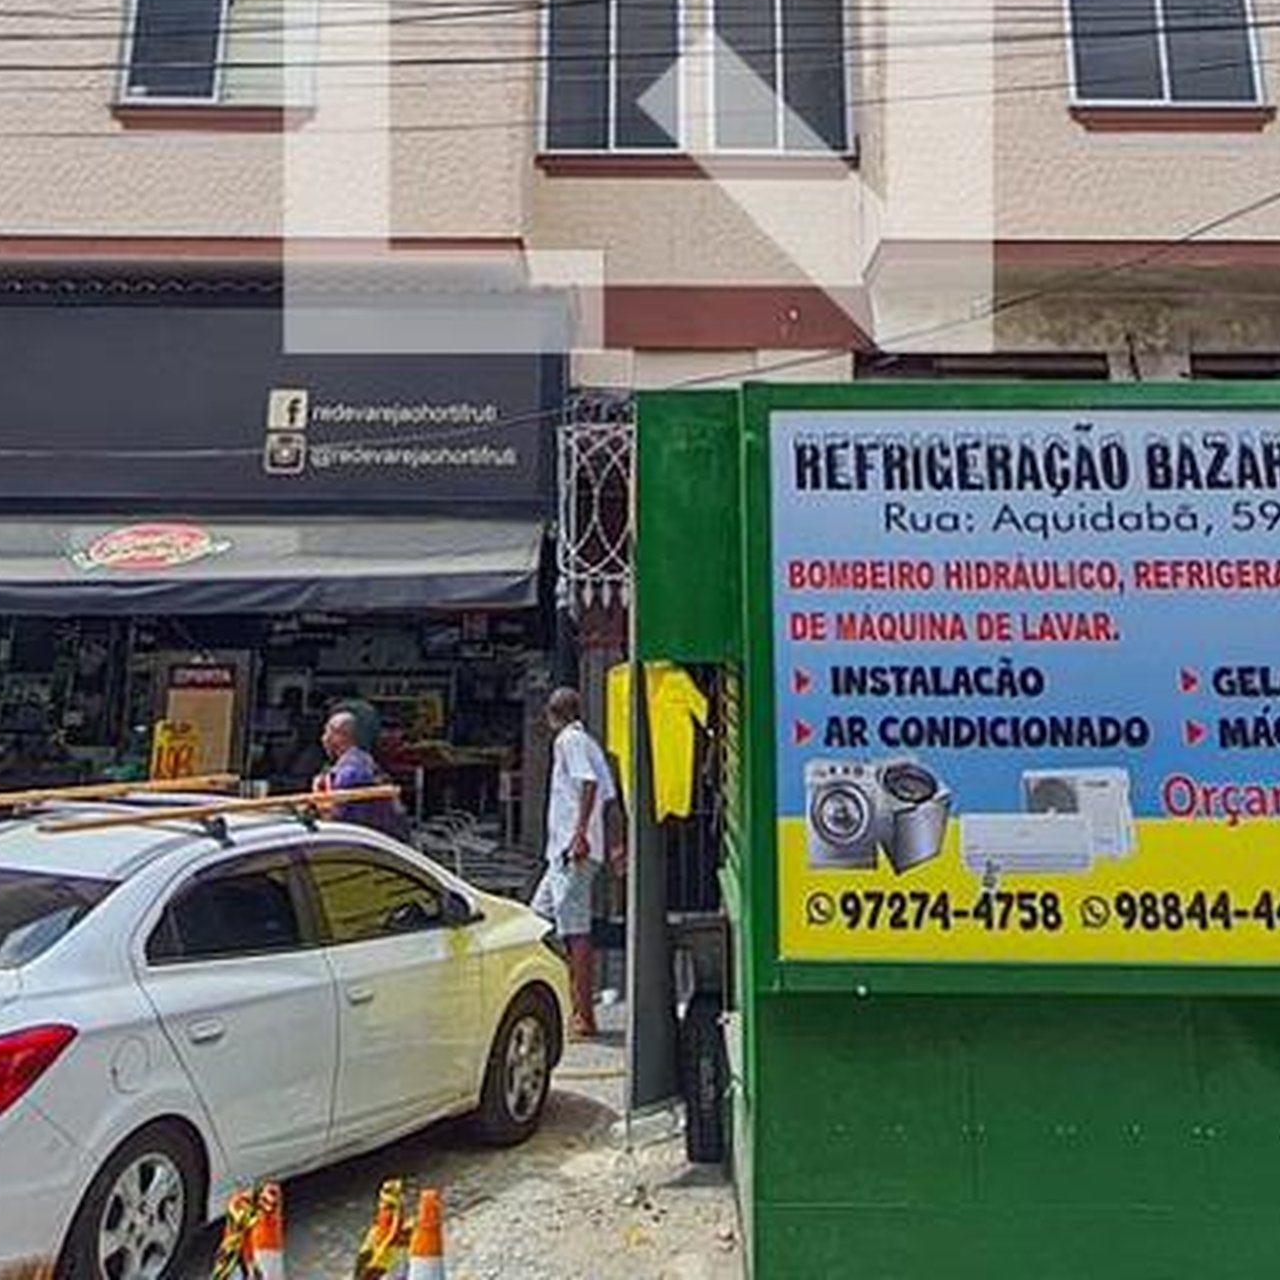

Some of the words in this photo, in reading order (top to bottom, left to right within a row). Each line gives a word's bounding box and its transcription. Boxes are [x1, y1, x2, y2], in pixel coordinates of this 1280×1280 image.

[793, 423, 1130, 498] REFRIGERAÇÃO
[884, 502, 974, 533] Rua:
[991, 501, 1213, 539] Aquidabã,
[788, 560, 935, 590] BOMBEIRO
[944, 554, 1125, 595] HIDRÁULICO,
[789, 612, 826, 641] DE
[836, 606, 968, 643] MÁQUINA
[976, 612, 1012, 641] DE
[1021, 612, 1121, 641] LAVAR.
[824, 717, 869, 748] AR
[878, 717, 1151, 749] CONDICIONADO
[839, 891, 1063, 930] 97274-4758
